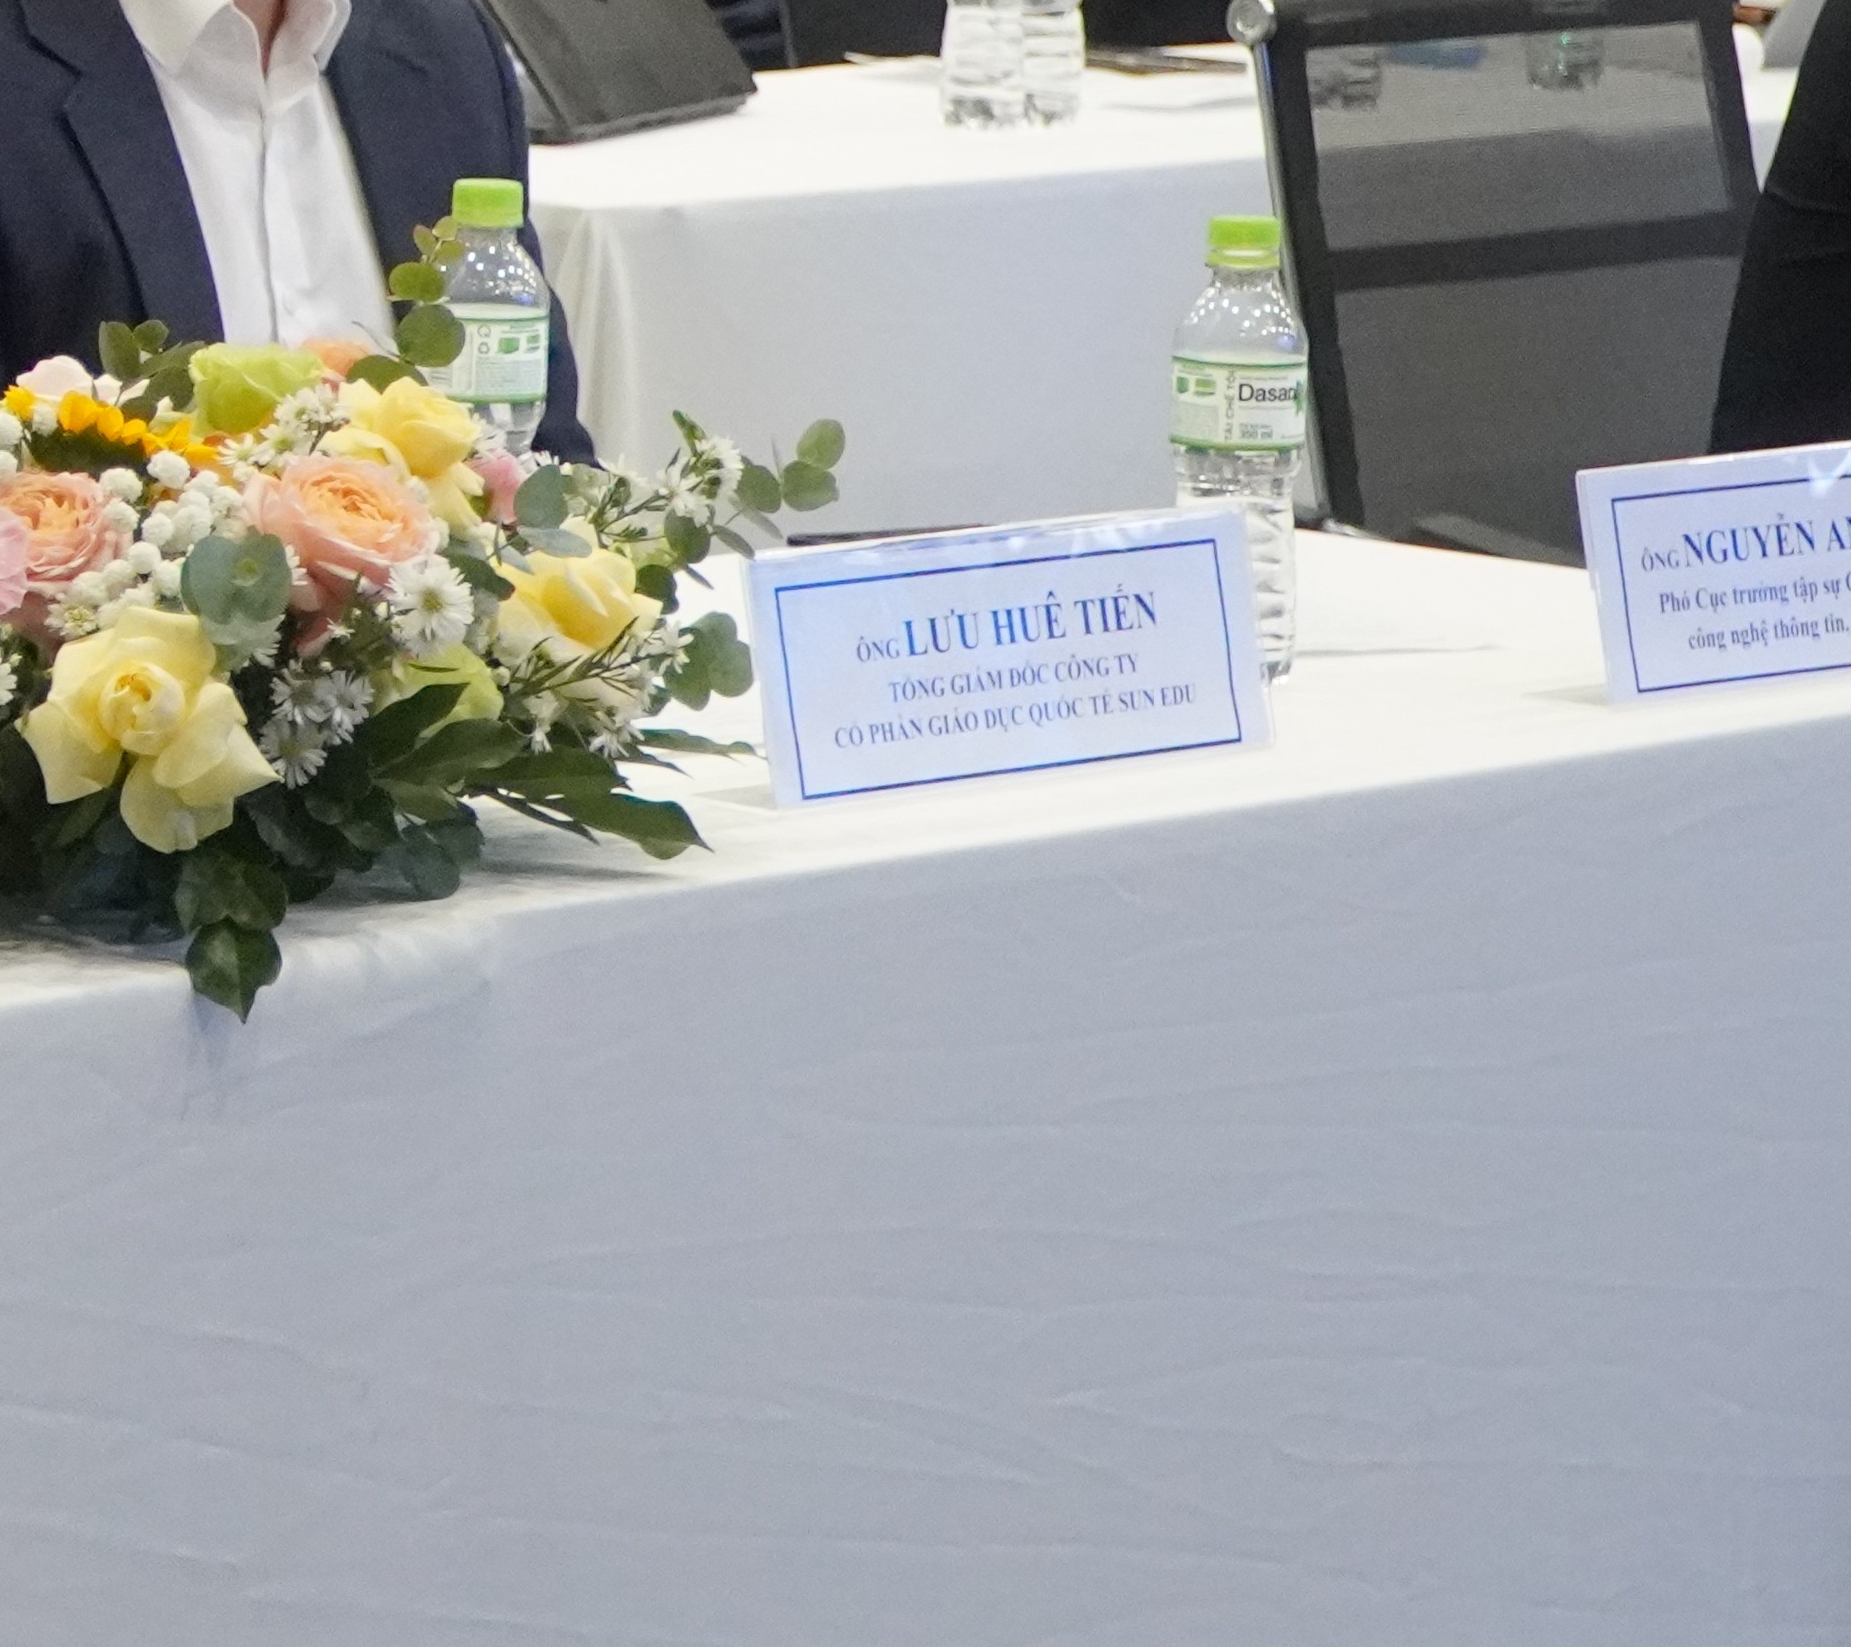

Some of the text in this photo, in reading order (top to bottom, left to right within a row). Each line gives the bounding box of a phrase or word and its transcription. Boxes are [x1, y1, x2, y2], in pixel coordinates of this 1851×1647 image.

[1641, 546, 1680, 572] ÔNG
[1682, 513, 1815, 568] NGUYỄN
[1659, 589, 1691, 613] Phó
[1695, 587, 1728, 613] Cục
[1733, 580, 1789, 606] trưởng
[1793, 576, 1818, 603] tập
[1823, 578, 1841, 600] sự
[856, 583, 1157, 662] ÔNG LƯU HUÊ TIẾN
[1688, 626, 1727, 650] công
[1730, 619, 1768, 650] nghệ
[1773, 616, 1821, 641] thông
[888, 652, 1139, 703] TỔNG GIÁM ĐỐC CÔNG TY
[834, 683, 1196, 748] CỔ PHẦN GIÁO DỤC QUỐC TẾ SUN EDU
